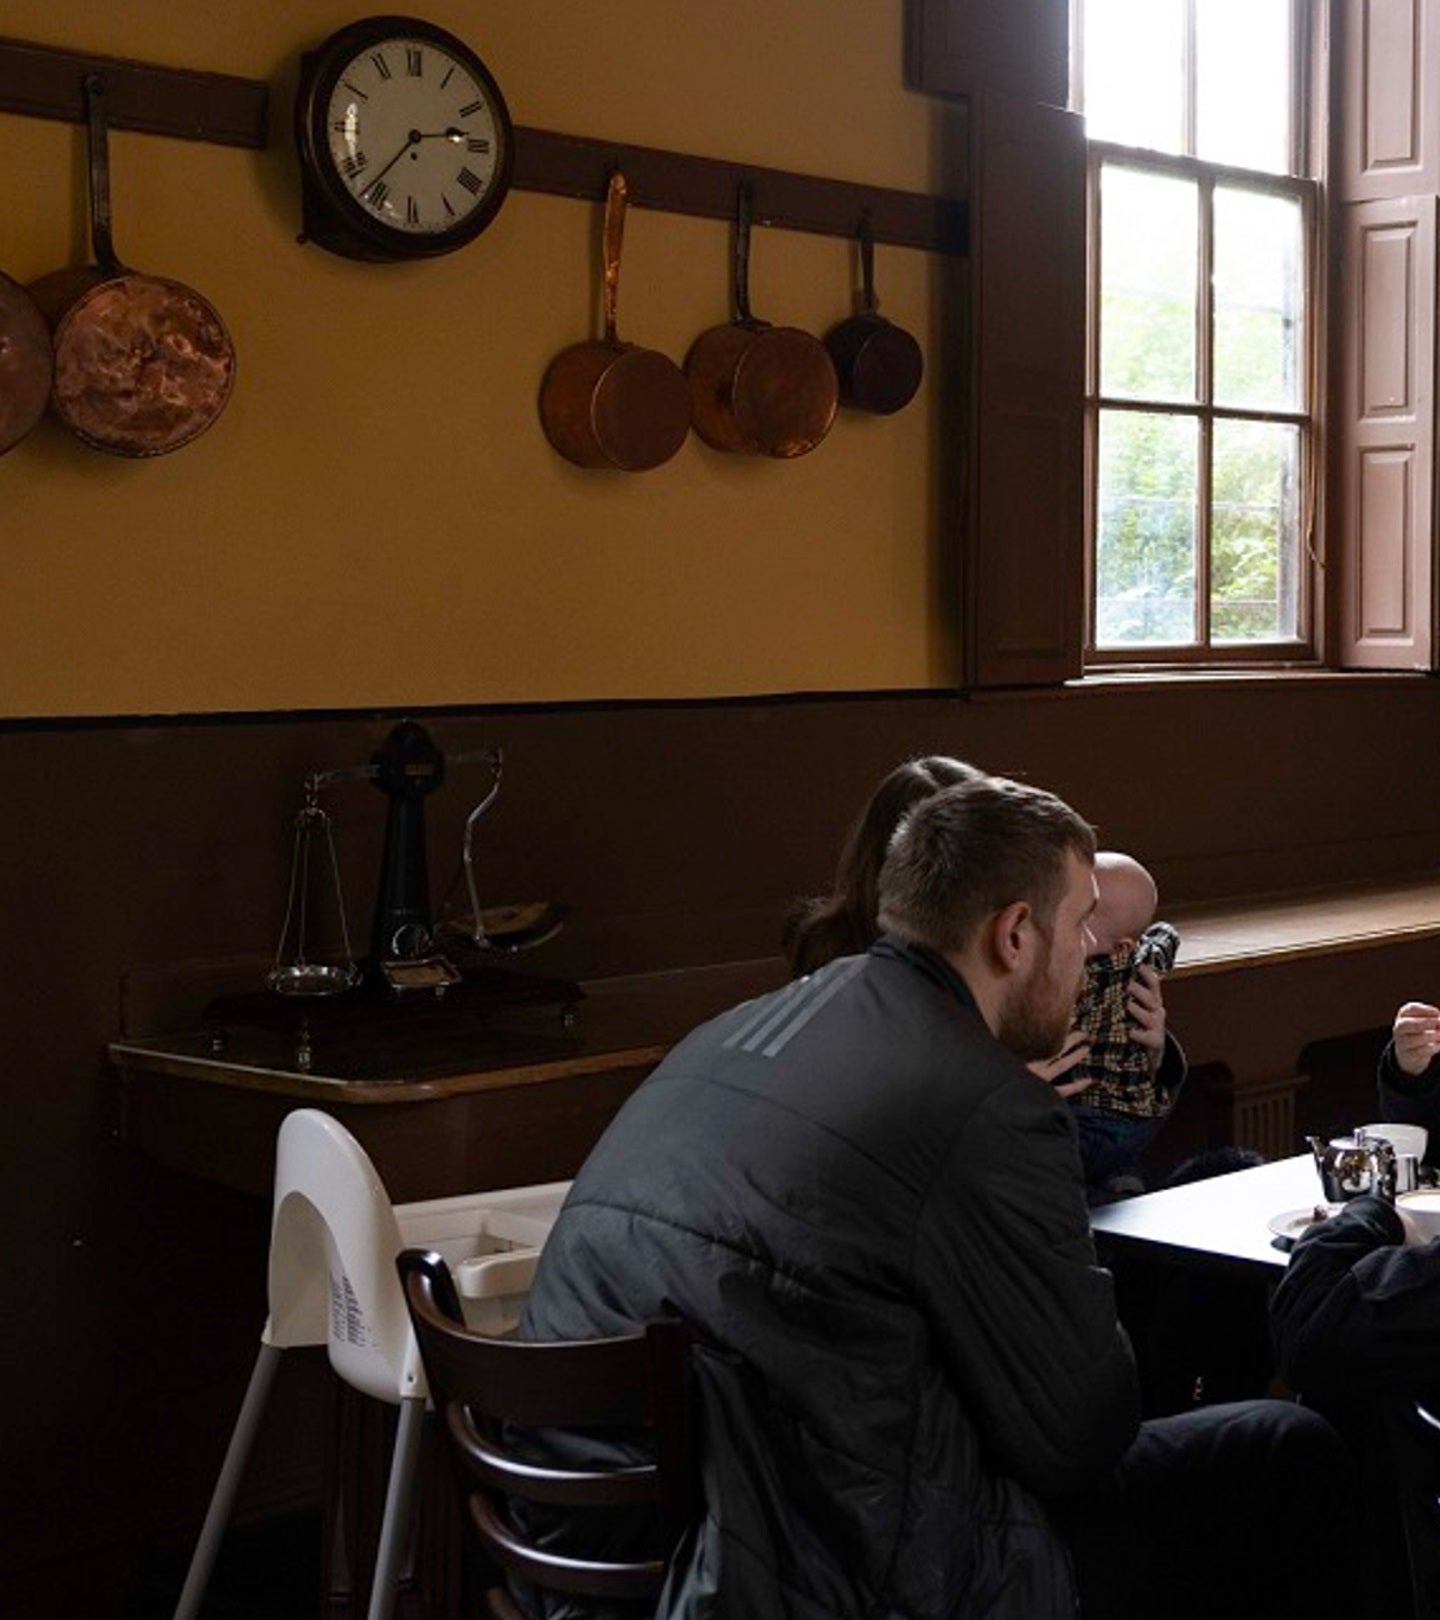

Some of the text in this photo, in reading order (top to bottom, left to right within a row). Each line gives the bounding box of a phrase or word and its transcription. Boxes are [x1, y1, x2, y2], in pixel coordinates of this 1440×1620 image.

[370, 53, 391, 79] XI
[405, 46, 422, 77] XII
[440, 66, 455, 89] I
[459, 101, 482, 118] II
[467, 138, 490, 154] III
[406, 195, 420, 224] VI
